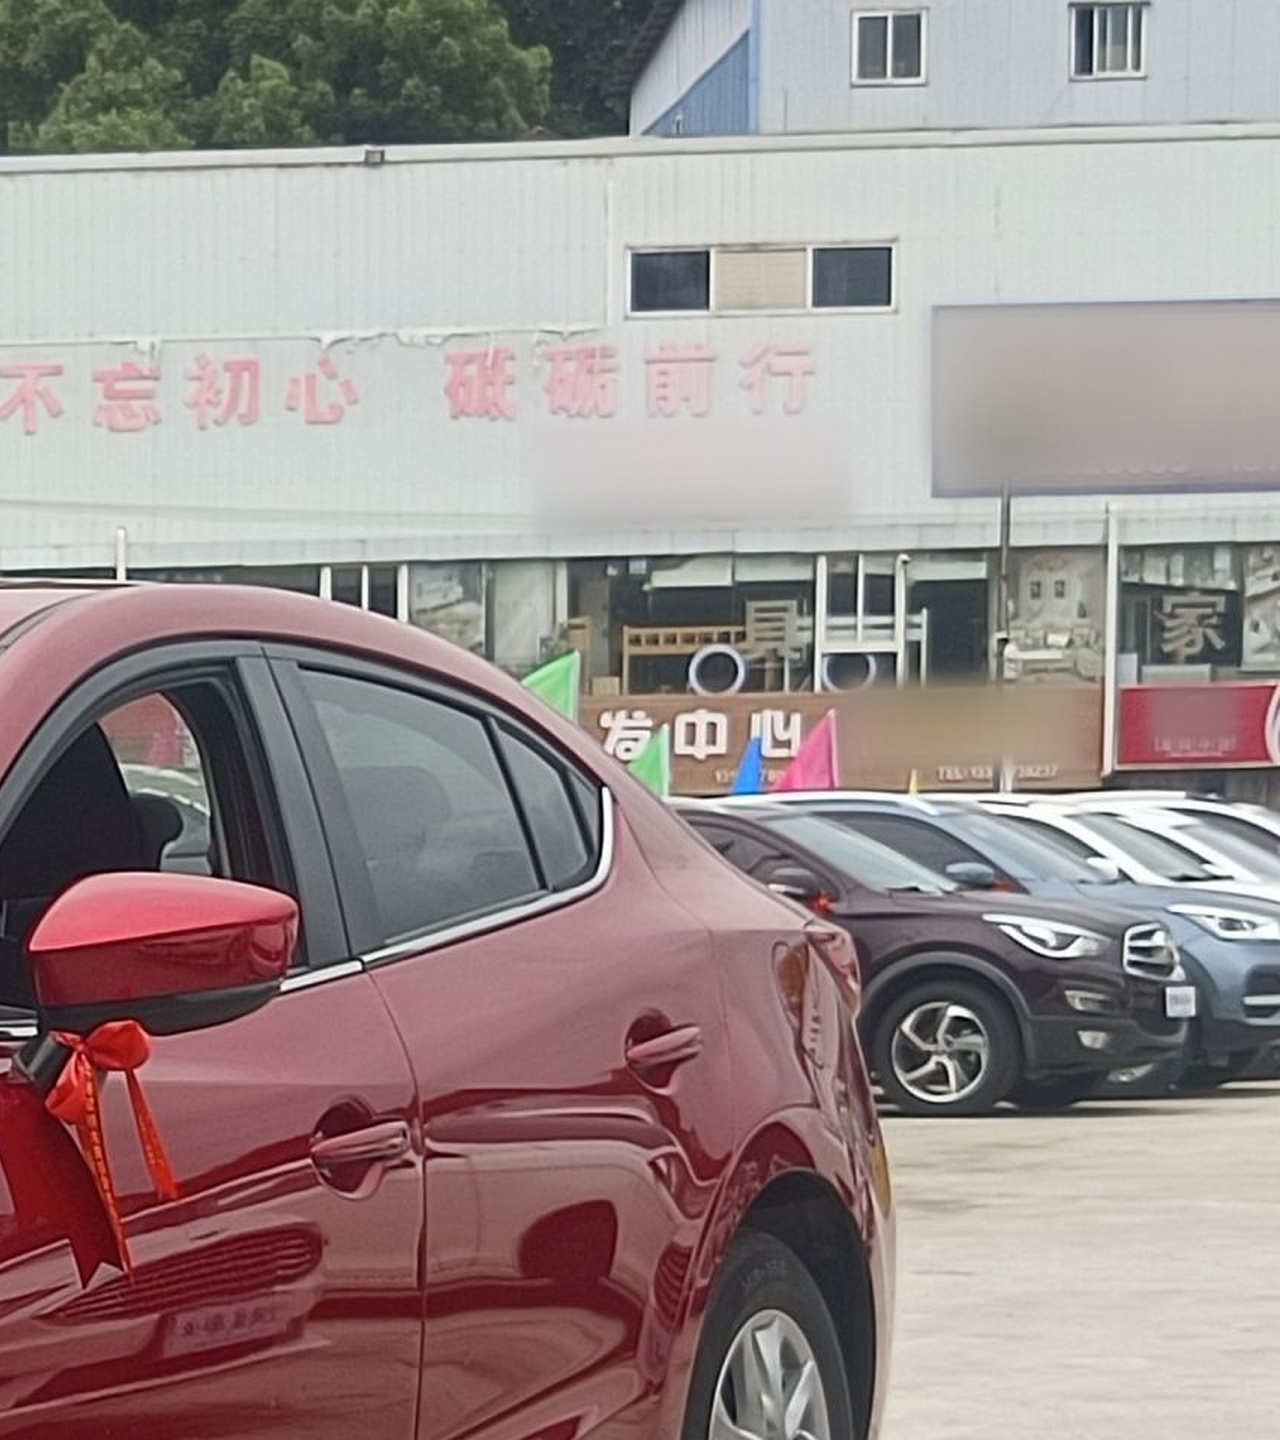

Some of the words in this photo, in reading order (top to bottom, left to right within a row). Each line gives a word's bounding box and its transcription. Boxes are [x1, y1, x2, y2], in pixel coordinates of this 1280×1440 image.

[444, 343, 816, 421] 砥砺前行
[599, 708, 802, 760] 发中心
